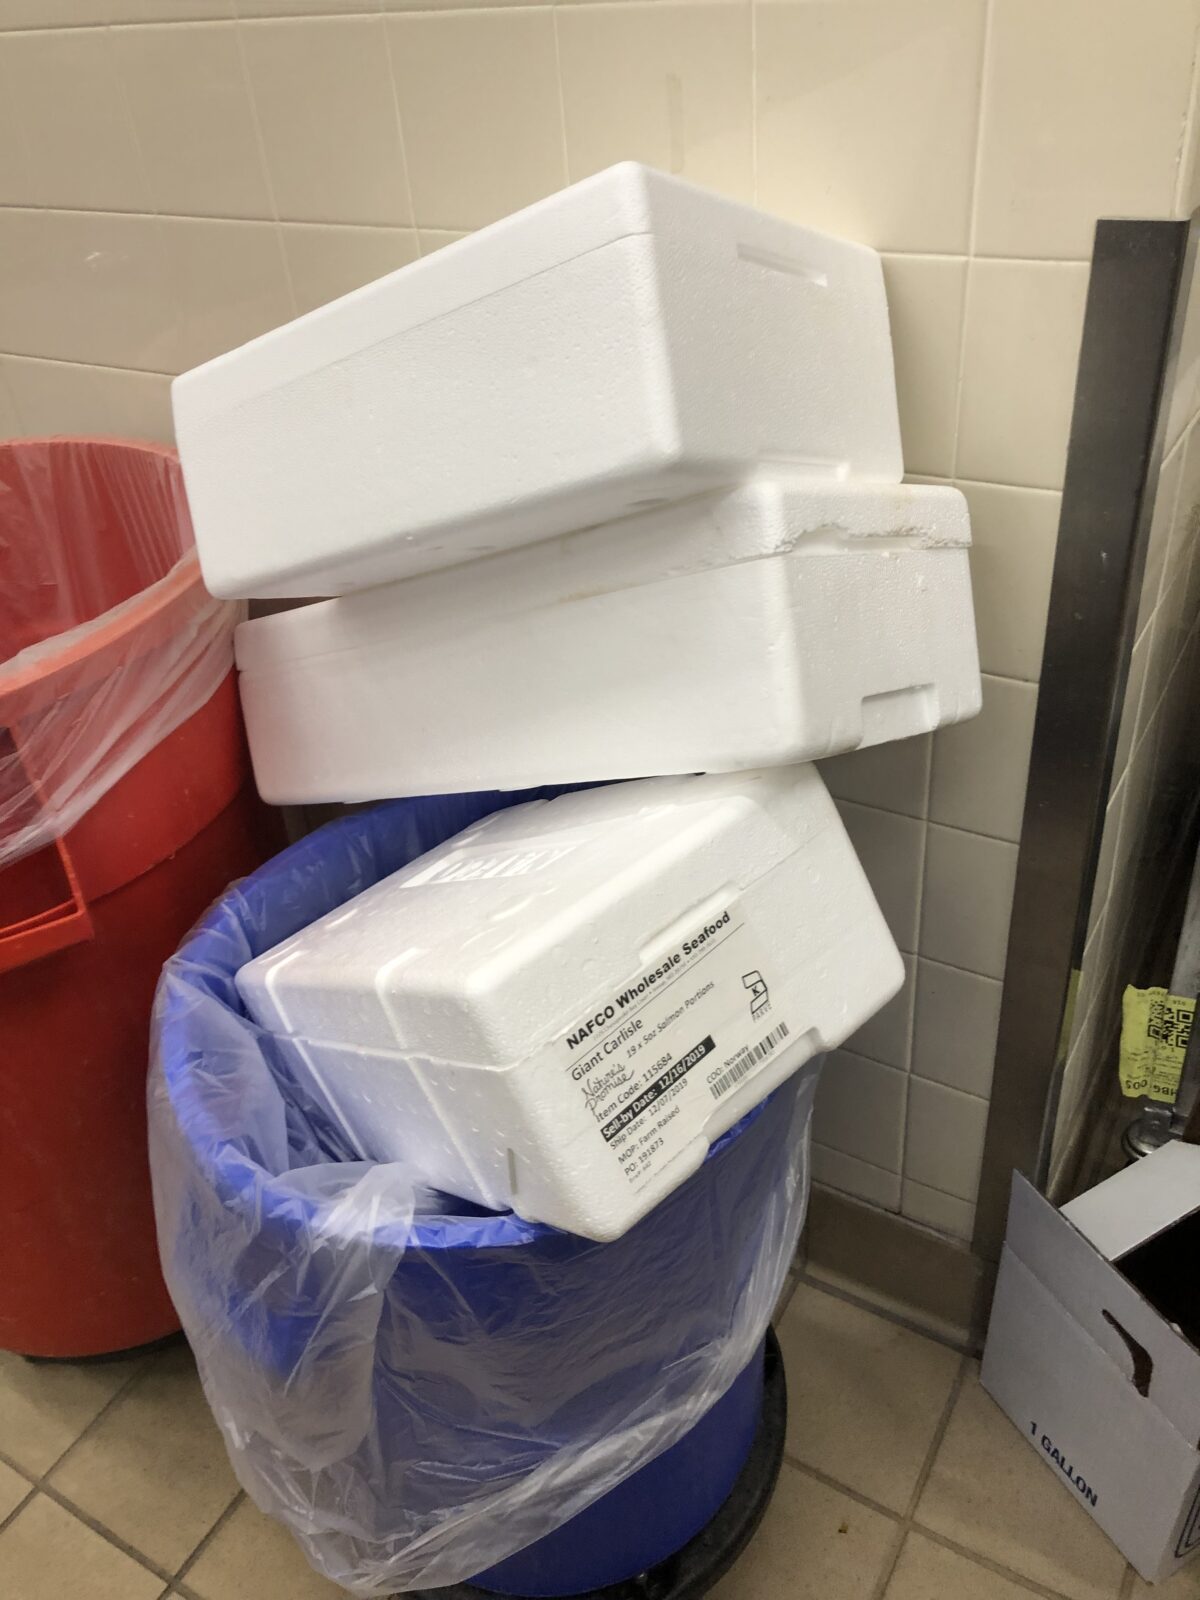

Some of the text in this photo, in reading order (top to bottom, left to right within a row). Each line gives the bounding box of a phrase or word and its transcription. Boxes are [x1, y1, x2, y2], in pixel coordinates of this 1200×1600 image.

[566, 1006, 614, 1049] NAFCO
[615, 954, 680, 1008] Wholesale
[682, 911, 730, 955] Seafood
[572, 1020, 643, 1080] Giant Carlisle
[627, 1046, 639, 1058] 19
[657, 1007, 684, 1032] Salmon
[685, 982, 714, 1008] Portions
[581, 1064, 626, 1100] Nature's
[594, 1053, 672, 1122] Item Code: 115684
[724, 1045, 751, 1068] Norway
[585, 1068, 634, 1116] Promise
[601, 1110, 636, 1139] Sell-by
[632, 1089, 657, 1112] Date:
[658, 1045, 706, 1090] 12/16/2019
[610, 1134, 627, 1150] Ship
[649, 1078, 687, 1116] 12/07/2019
[618, 1106, 680, 1164] MOP: Farm Raised
[624, 1162, 638, 1175] PO:
[638, 1138, 664, 1163] 191873
[1030, 1421, 1098, 1508] 1 GALLON
